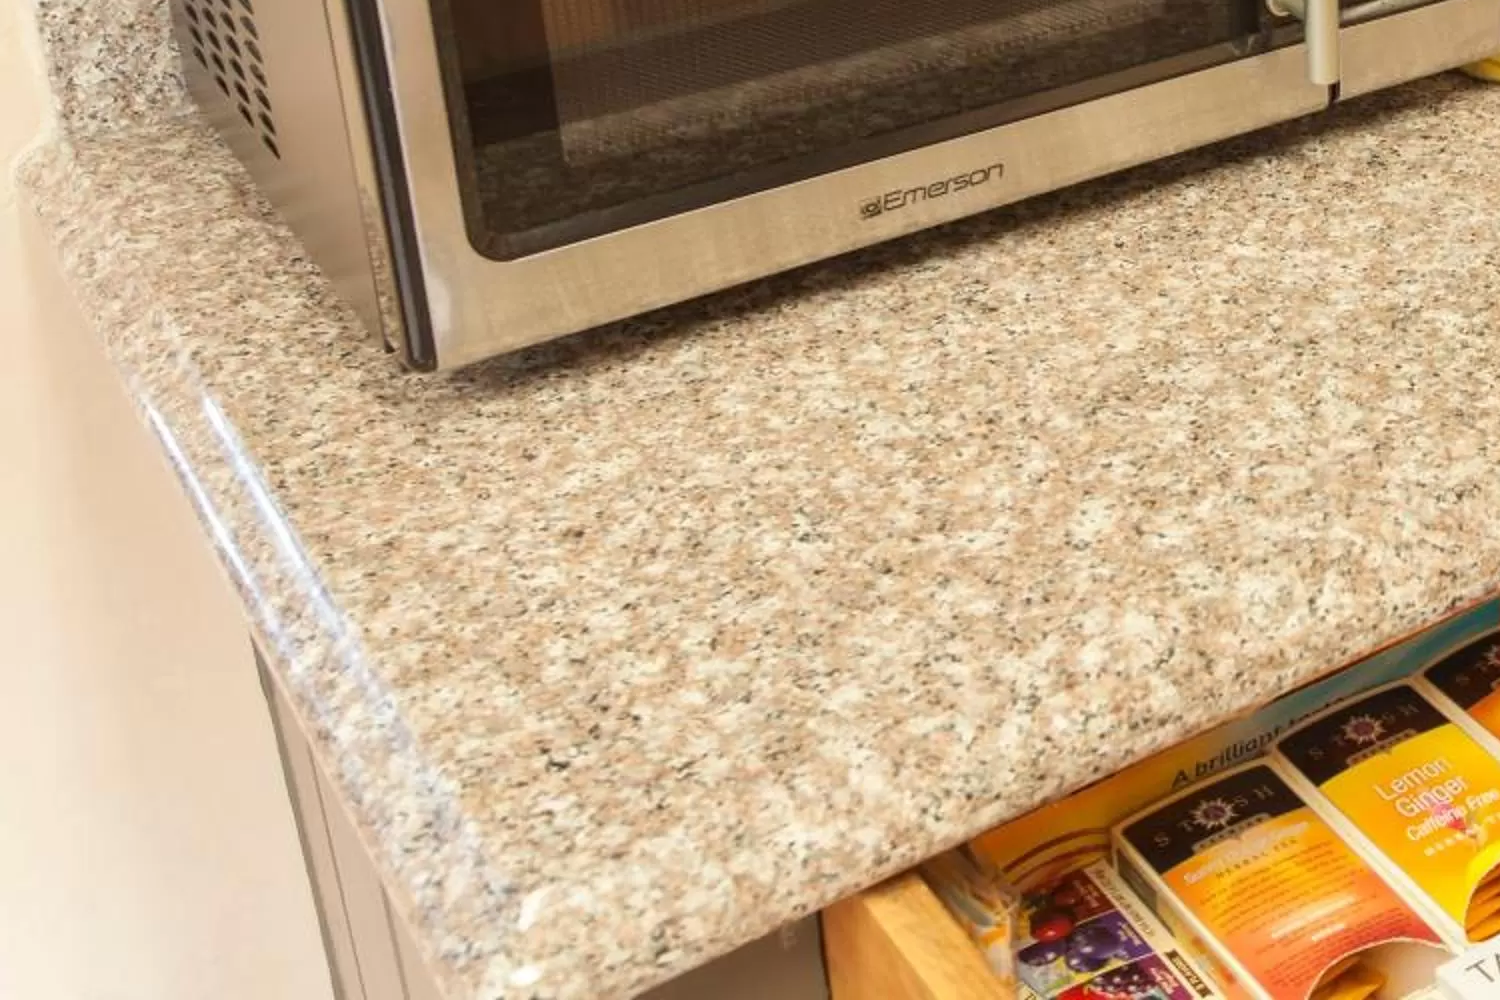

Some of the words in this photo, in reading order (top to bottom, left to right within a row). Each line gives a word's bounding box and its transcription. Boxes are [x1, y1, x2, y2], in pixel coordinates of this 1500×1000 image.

[883, 163, 1005, 212] Emerson
[1171, 769, 1190, 789] A
[1194, 724, 1283, 778] brilliant
[1373, 756, 1453, 801] Lemon
[1395, 774, 1470, 818] Ginger
[1406, 801, 1469, 841] Caffeine
